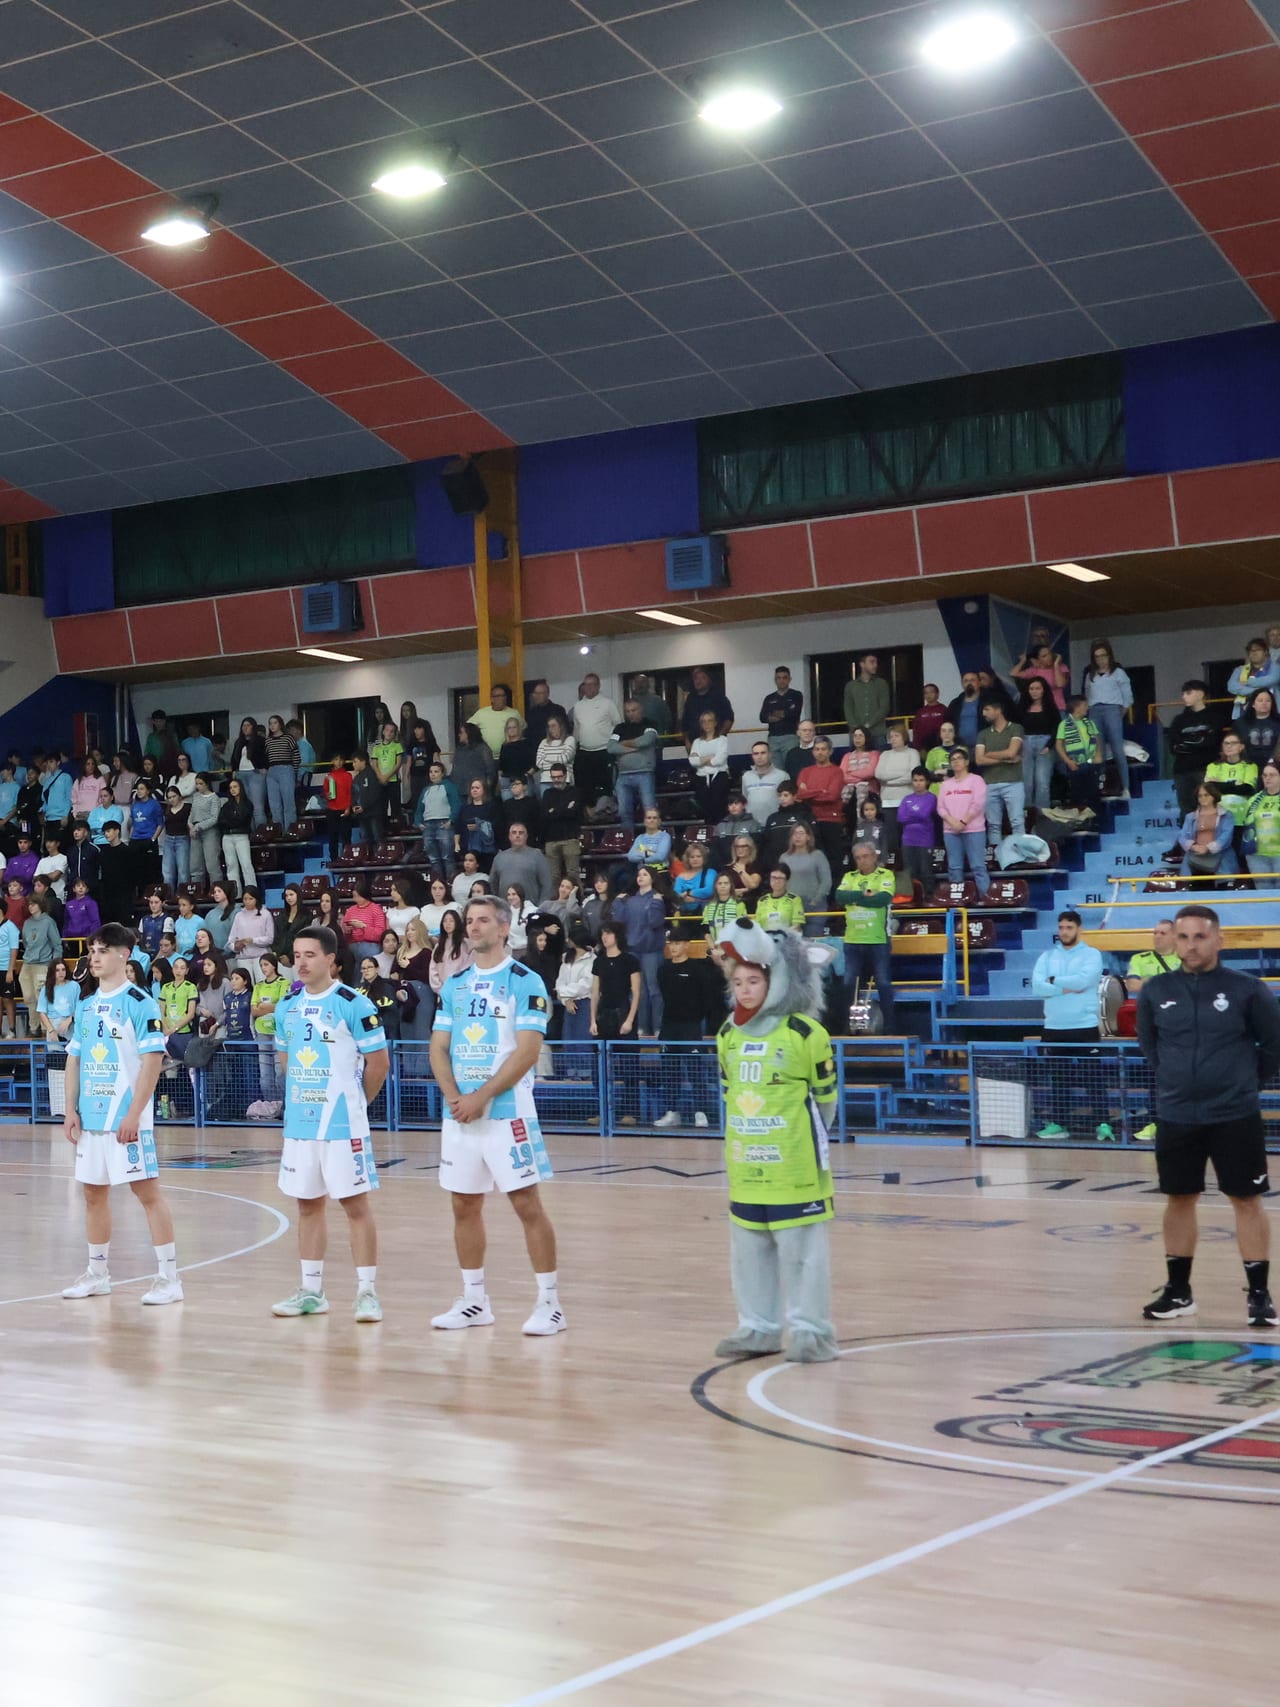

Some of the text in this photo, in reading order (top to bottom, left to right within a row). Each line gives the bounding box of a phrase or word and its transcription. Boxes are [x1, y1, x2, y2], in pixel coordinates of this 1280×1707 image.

[1144, 818, 1173, 829] FILA
[1115, 856, 1154, 866] FILA 4
[304, 1007, 319, 1016] gaza
[468, 998, 487, 1017] 19
[303, 1023, 313, 1041] 3
[470, 1045, 501, 1053] RURAL
[96, 1063, 121, 1071] RURAL
[738, 1061, 762, 1083] 00
[304, 1068, 333, 1077] RURAL
[301, 1095, 329, 1103] ZAMORA
[746, 1117, 785, 1127] RURAL
[126, 1143, 140, 1164] 8
[509, 1143, 533, 1169] 19
[353, 1154, 364, 1176] 3
